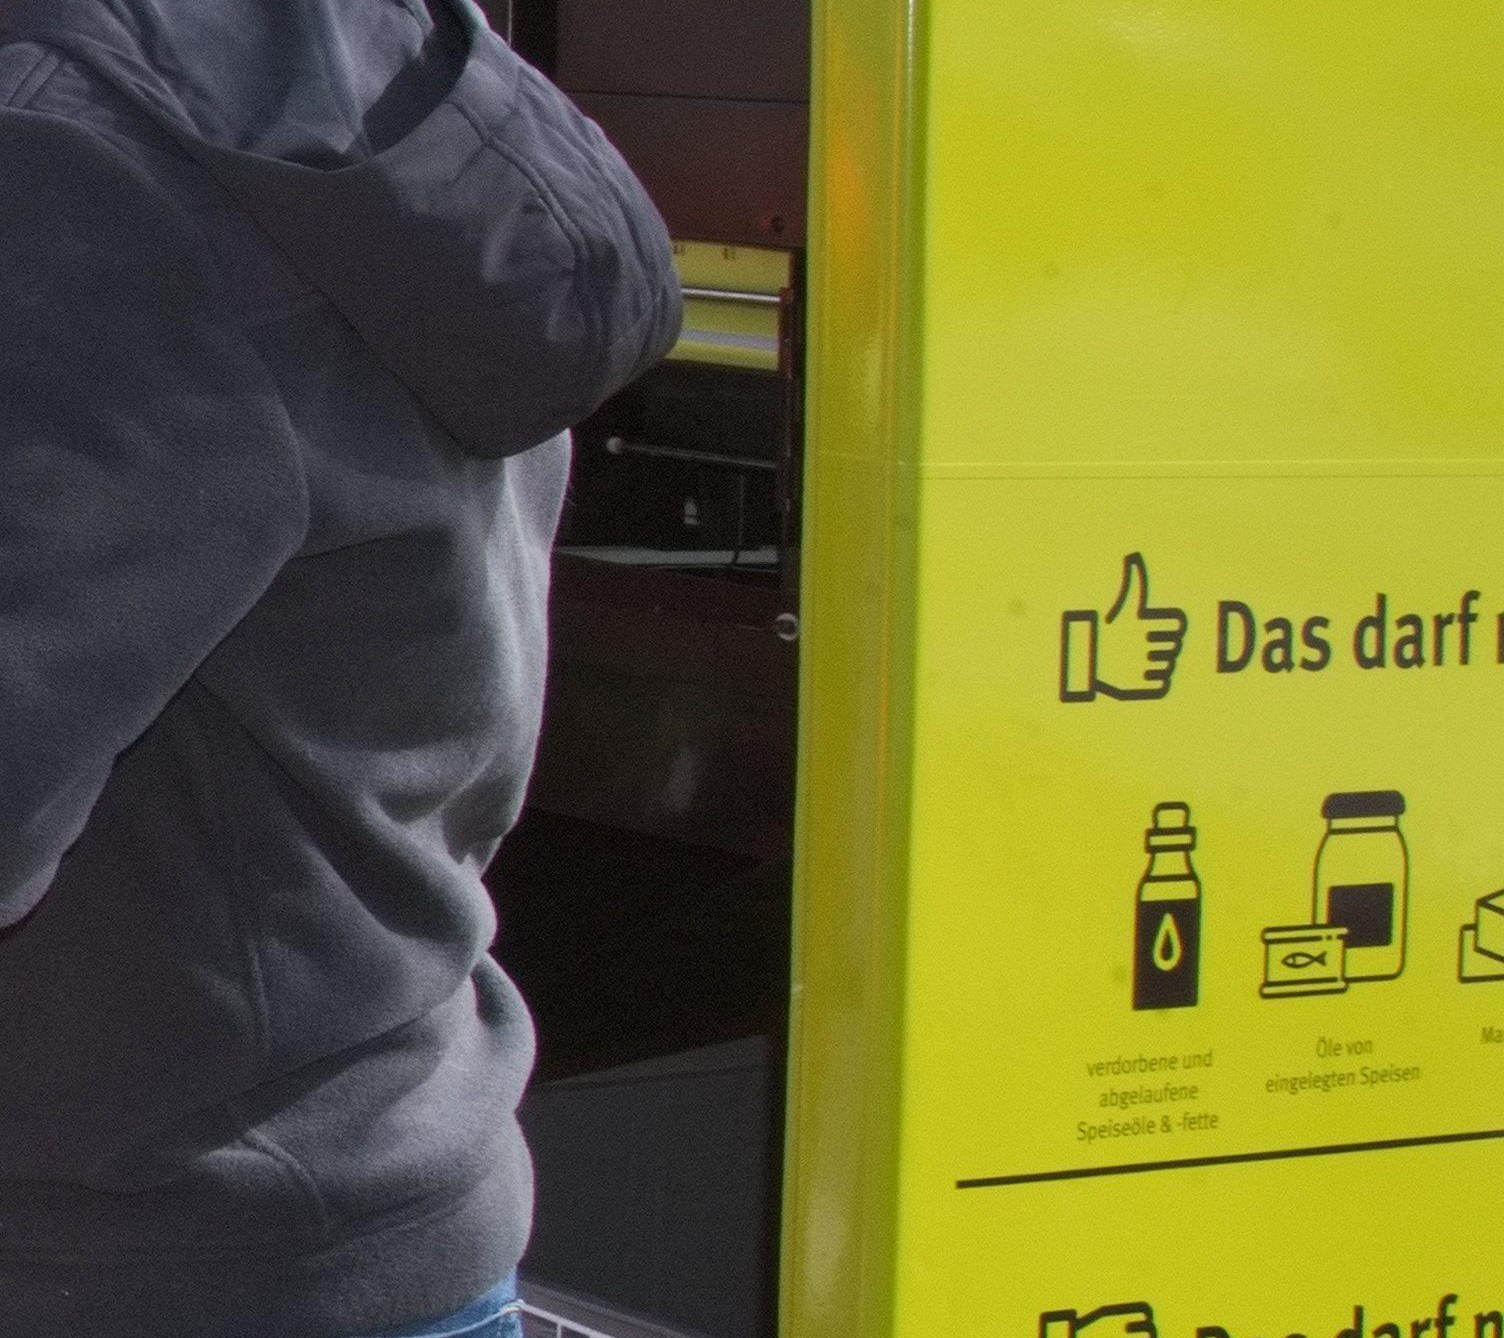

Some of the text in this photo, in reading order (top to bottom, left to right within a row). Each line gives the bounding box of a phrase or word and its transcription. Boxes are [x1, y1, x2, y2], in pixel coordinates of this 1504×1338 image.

[1216, 600, 1332, 673] Das
[1353, 590, 1481, 670] darf
[1316, 1036, 1374, 1058] Öle von
[1086, 1049, 1213, 1077] verdorbene und
[1265, 1064, 1421, 1096] eingelegten Speisen
[1099, 1082, 1199, 1110] abgelaufene
[1076, 1115, 1157, 1144] Speiseöle
